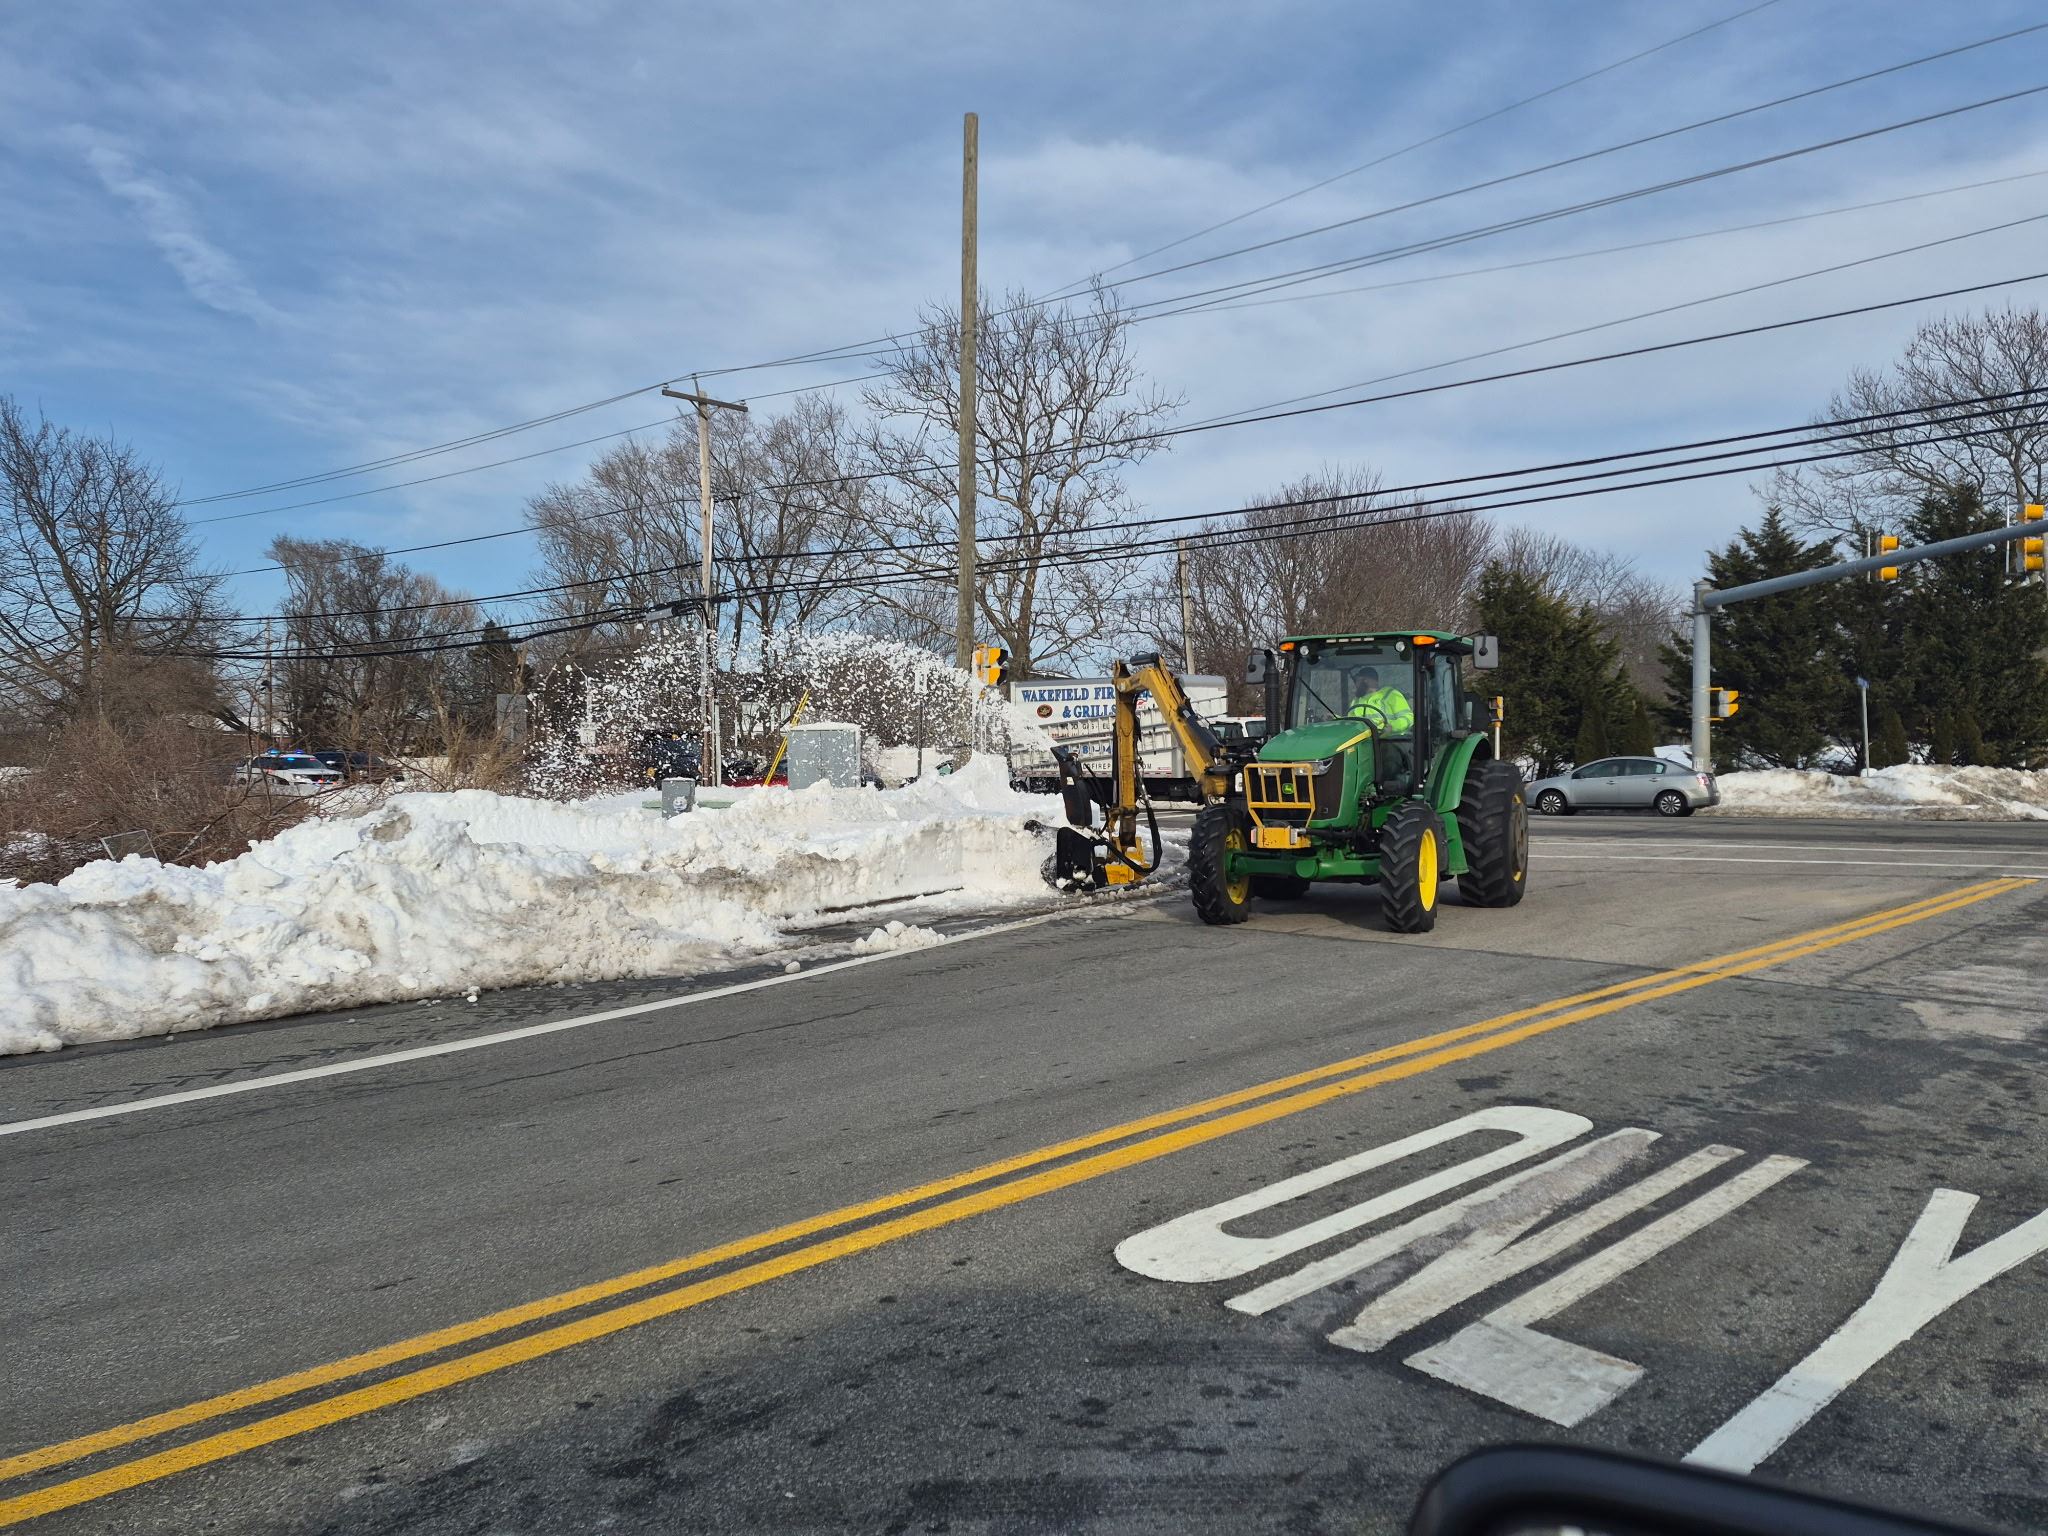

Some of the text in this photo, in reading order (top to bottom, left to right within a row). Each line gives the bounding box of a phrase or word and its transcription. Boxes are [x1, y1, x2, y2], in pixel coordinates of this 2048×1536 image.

[1021, 687, 1090, 703] WAKEFIELD
[1062, 705, 1072, 719] &
[1113, 1105, 2048, 1475] ONLY
